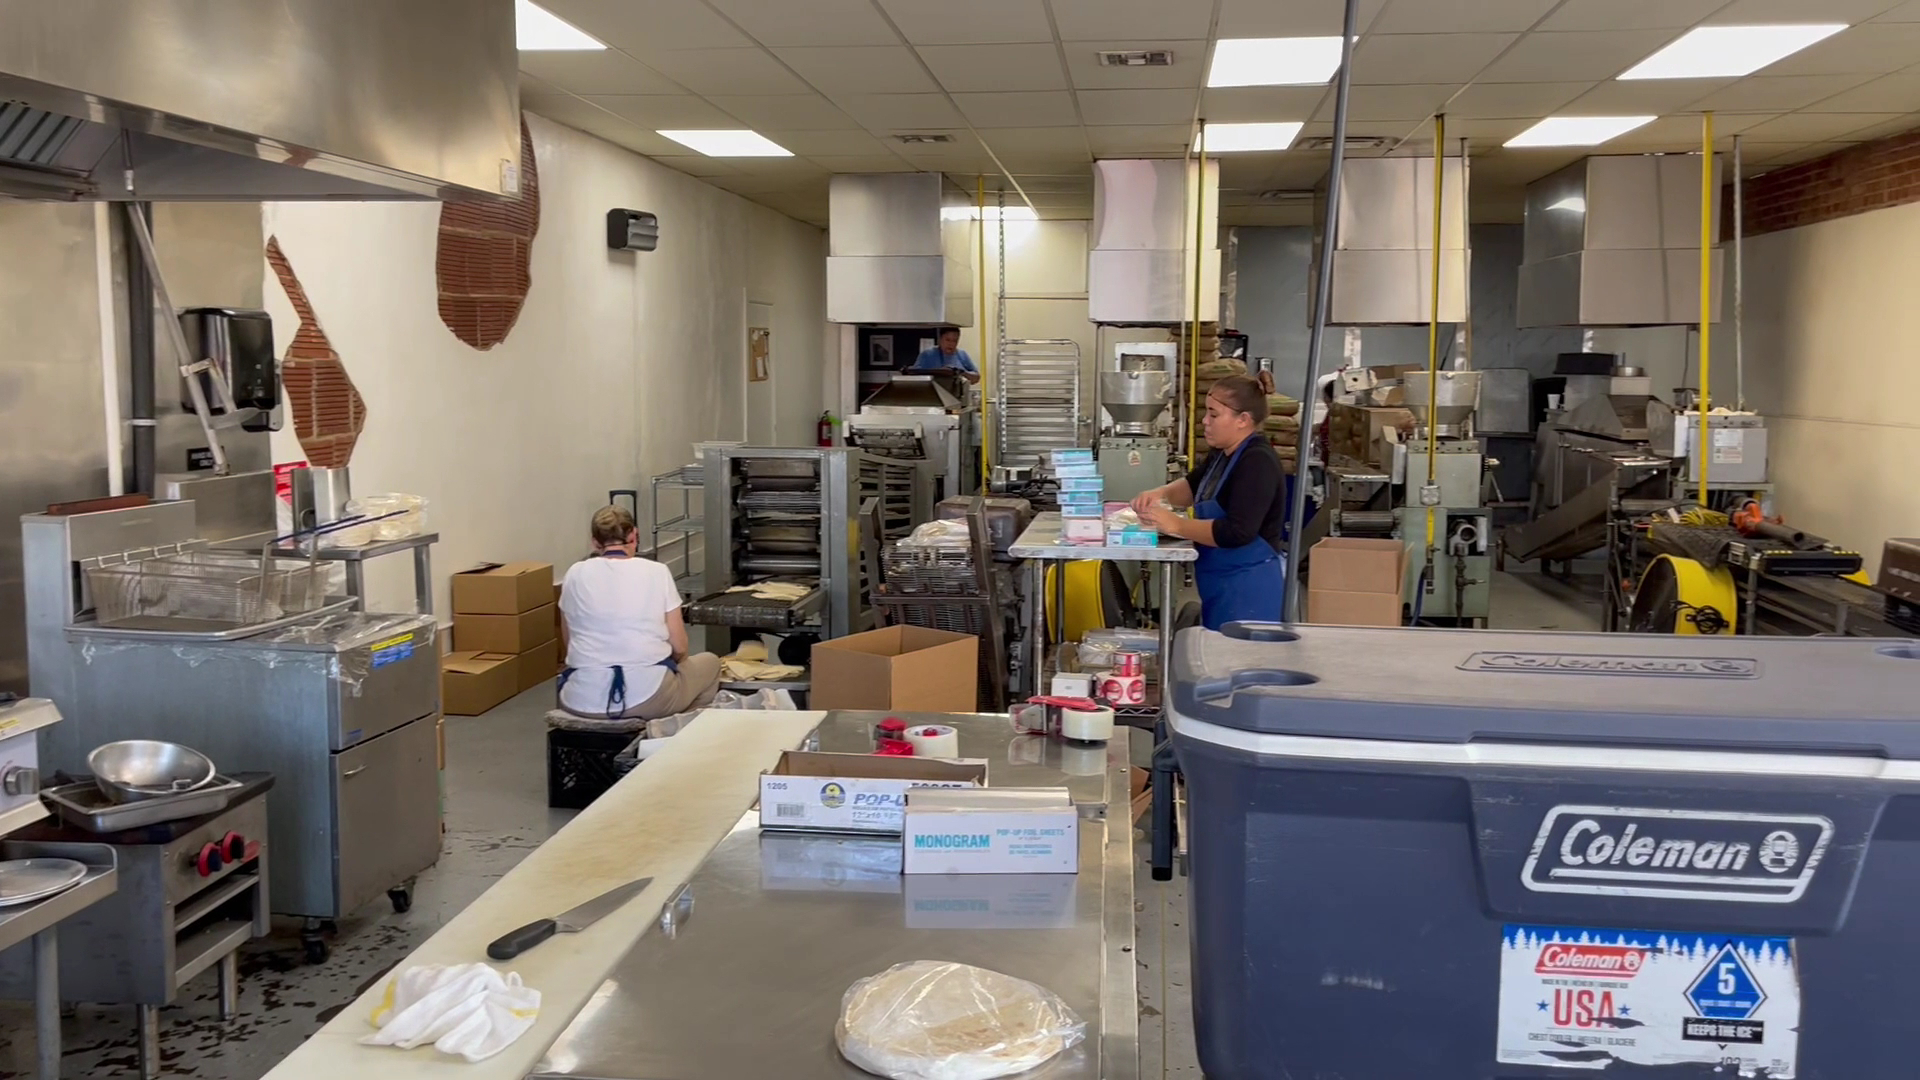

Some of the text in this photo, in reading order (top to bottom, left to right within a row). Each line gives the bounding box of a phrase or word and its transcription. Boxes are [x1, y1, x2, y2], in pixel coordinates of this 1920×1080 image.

[1482, 655, 1696, 672] Coleman
[767, 782, 788, 790] 1205
[853, 793, 904, 807] POP-U
[914, 834, 990, 848] MONOGRAM
[1560, 819, 1750, 870] Coleman
[1543, 946, 1623, 970] Coleman
[1718, 962, 1736, 994] 5
[1554, 988, 1616, 1028] USA
[1686, 1024, 1717, 1036] KEEPS
[1718, 1025, 1736, 1037] THE
